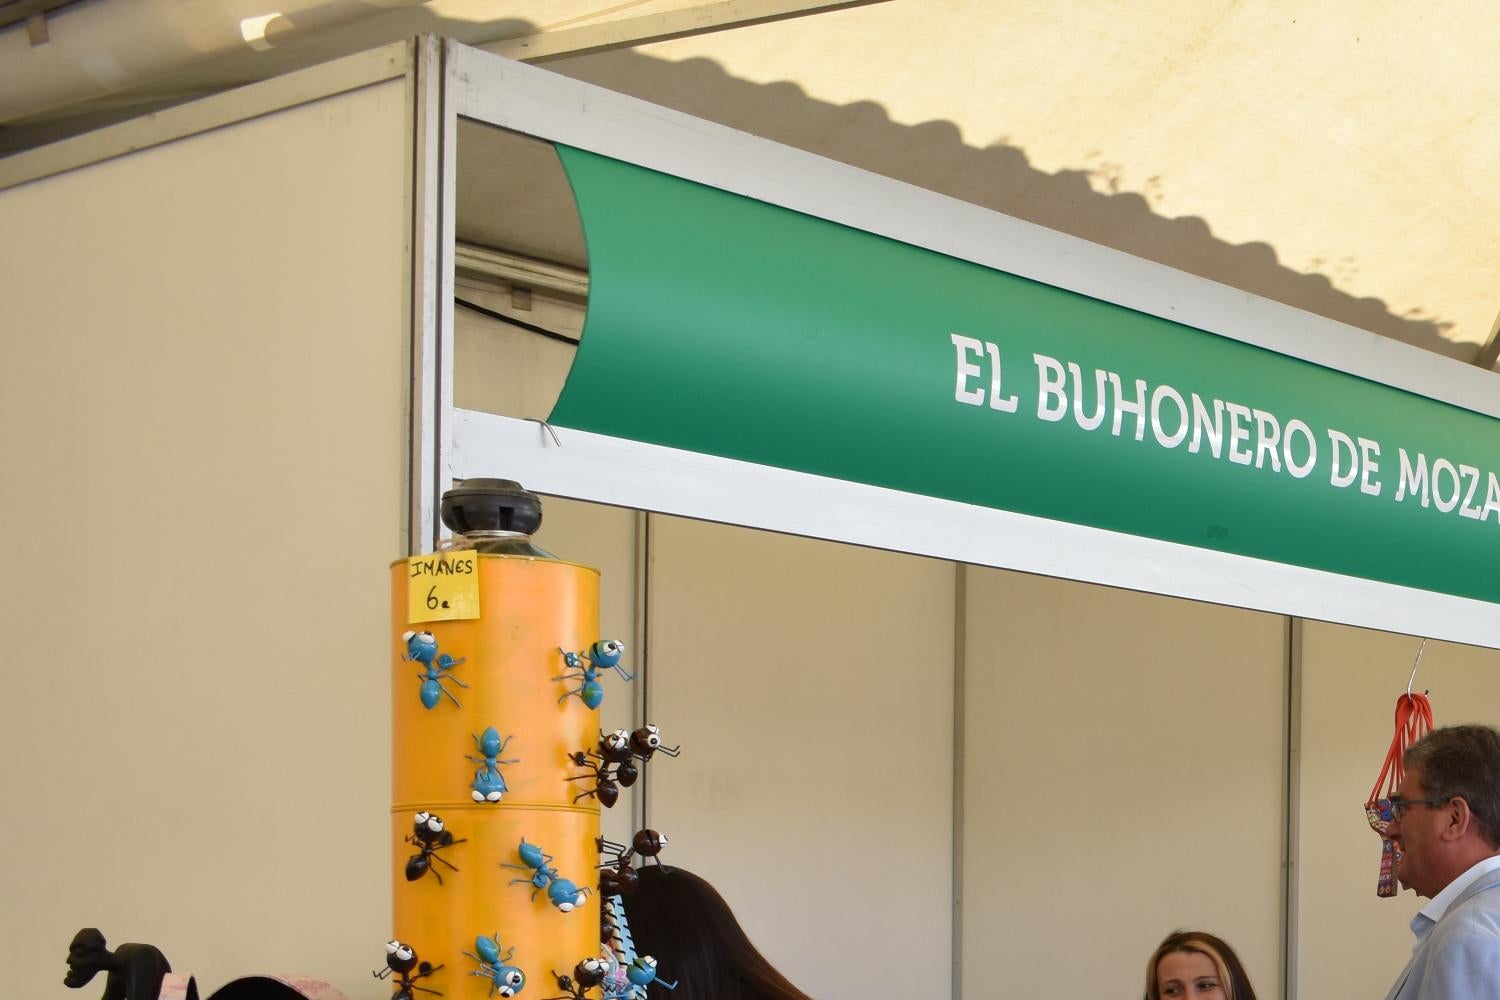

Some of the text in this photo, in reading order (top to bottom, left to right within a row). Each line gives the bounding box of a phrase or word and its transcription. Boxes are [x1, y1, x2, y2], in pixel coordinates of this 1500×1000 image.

[949, 332, 1019, 414] EL
[1033, 352, 1317, 480] BUHONERO
[1326, 428, 1383, 498] DE
[411, 558, 473, 577] IMANES
